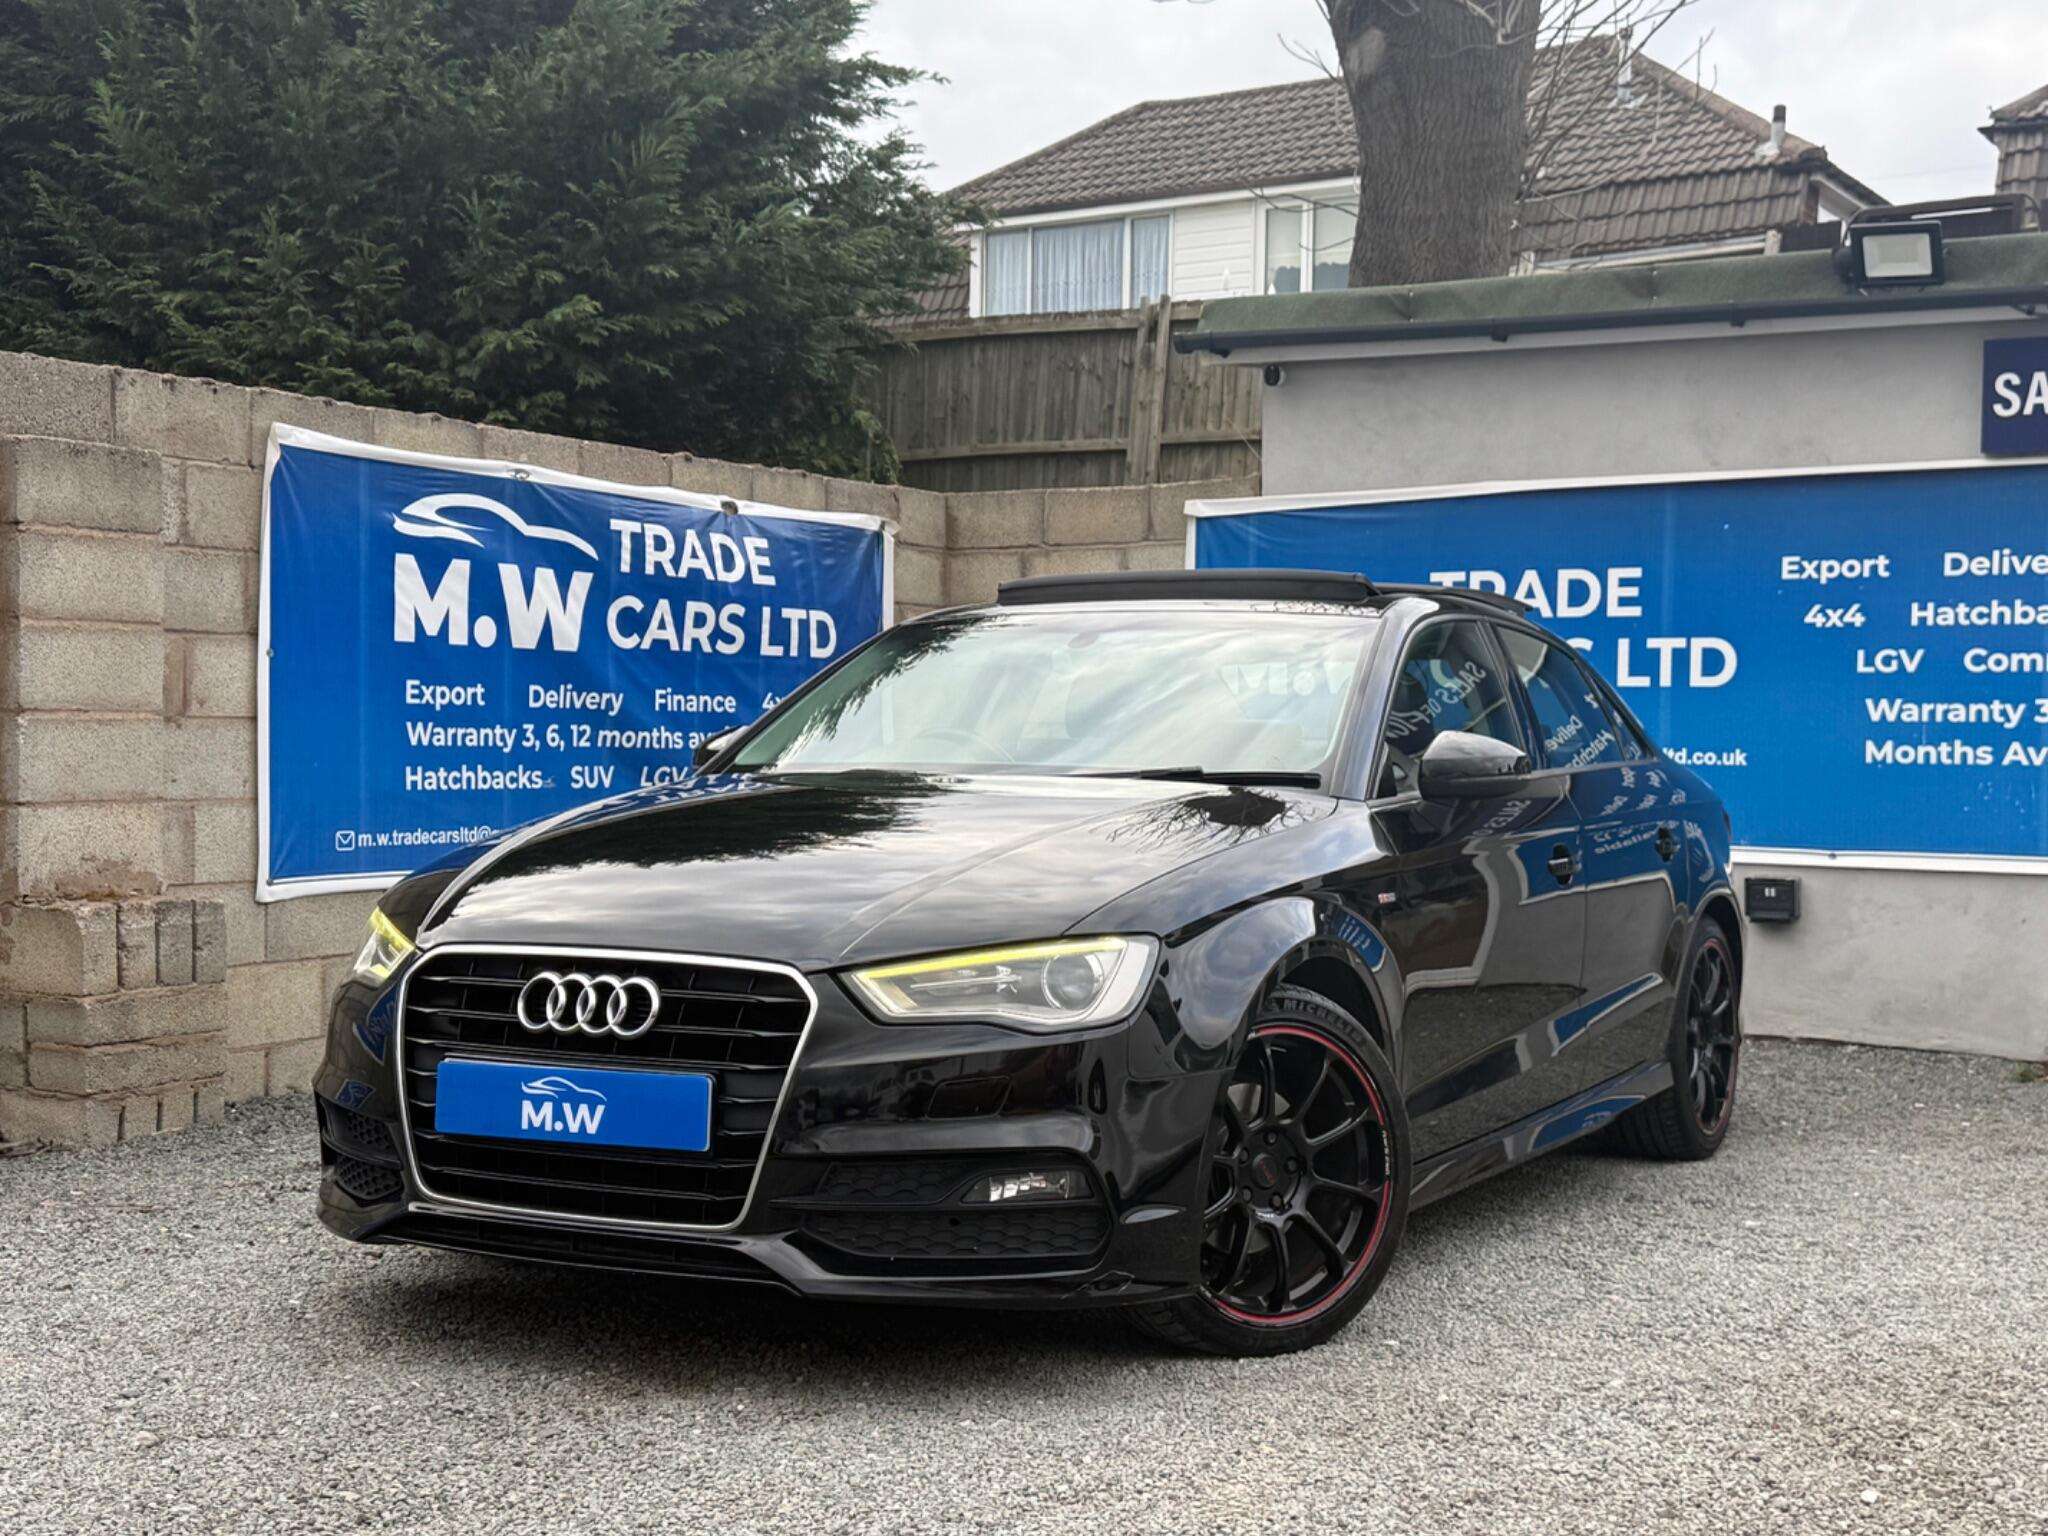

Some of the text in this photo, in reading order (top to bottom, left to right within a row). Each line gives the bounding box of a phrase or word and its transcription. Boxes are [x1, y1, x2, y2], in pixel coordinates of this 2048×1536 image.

[609, 518, 777, 586] TRADE
[1781, 548, 2048, 585] Export Delive
[394, 553, 594, 652] M.W
[1803, 603, 1866, 628] 4x4
[607, 595, 837, 659] CARS LTD
[1617, 637, 1738, 688] LTD
[1857, 647, 2048, 674] LGV Com
[405, 679, 485, 711] Export
[528, 684, 624, 716] Delivery
[654, 687, 737, 713] Finance
[1865, 697, 2026, 729] Warranty
[406, 721, 517, 753] Warranty
[521, 724, 541, 751] 3,
[545, 724, 565, 751] 6,
[570, 724, 592, 748] 12
[597, 725, 683, 750] months
[1865, 739, 1994, 765] Months
[405, 764, 691, 791] Hatchbacks SUV LGV
[358, 825, 498, 848] m.w.tradecarsltd@
[520, 1099, 606, 1136] M.W
